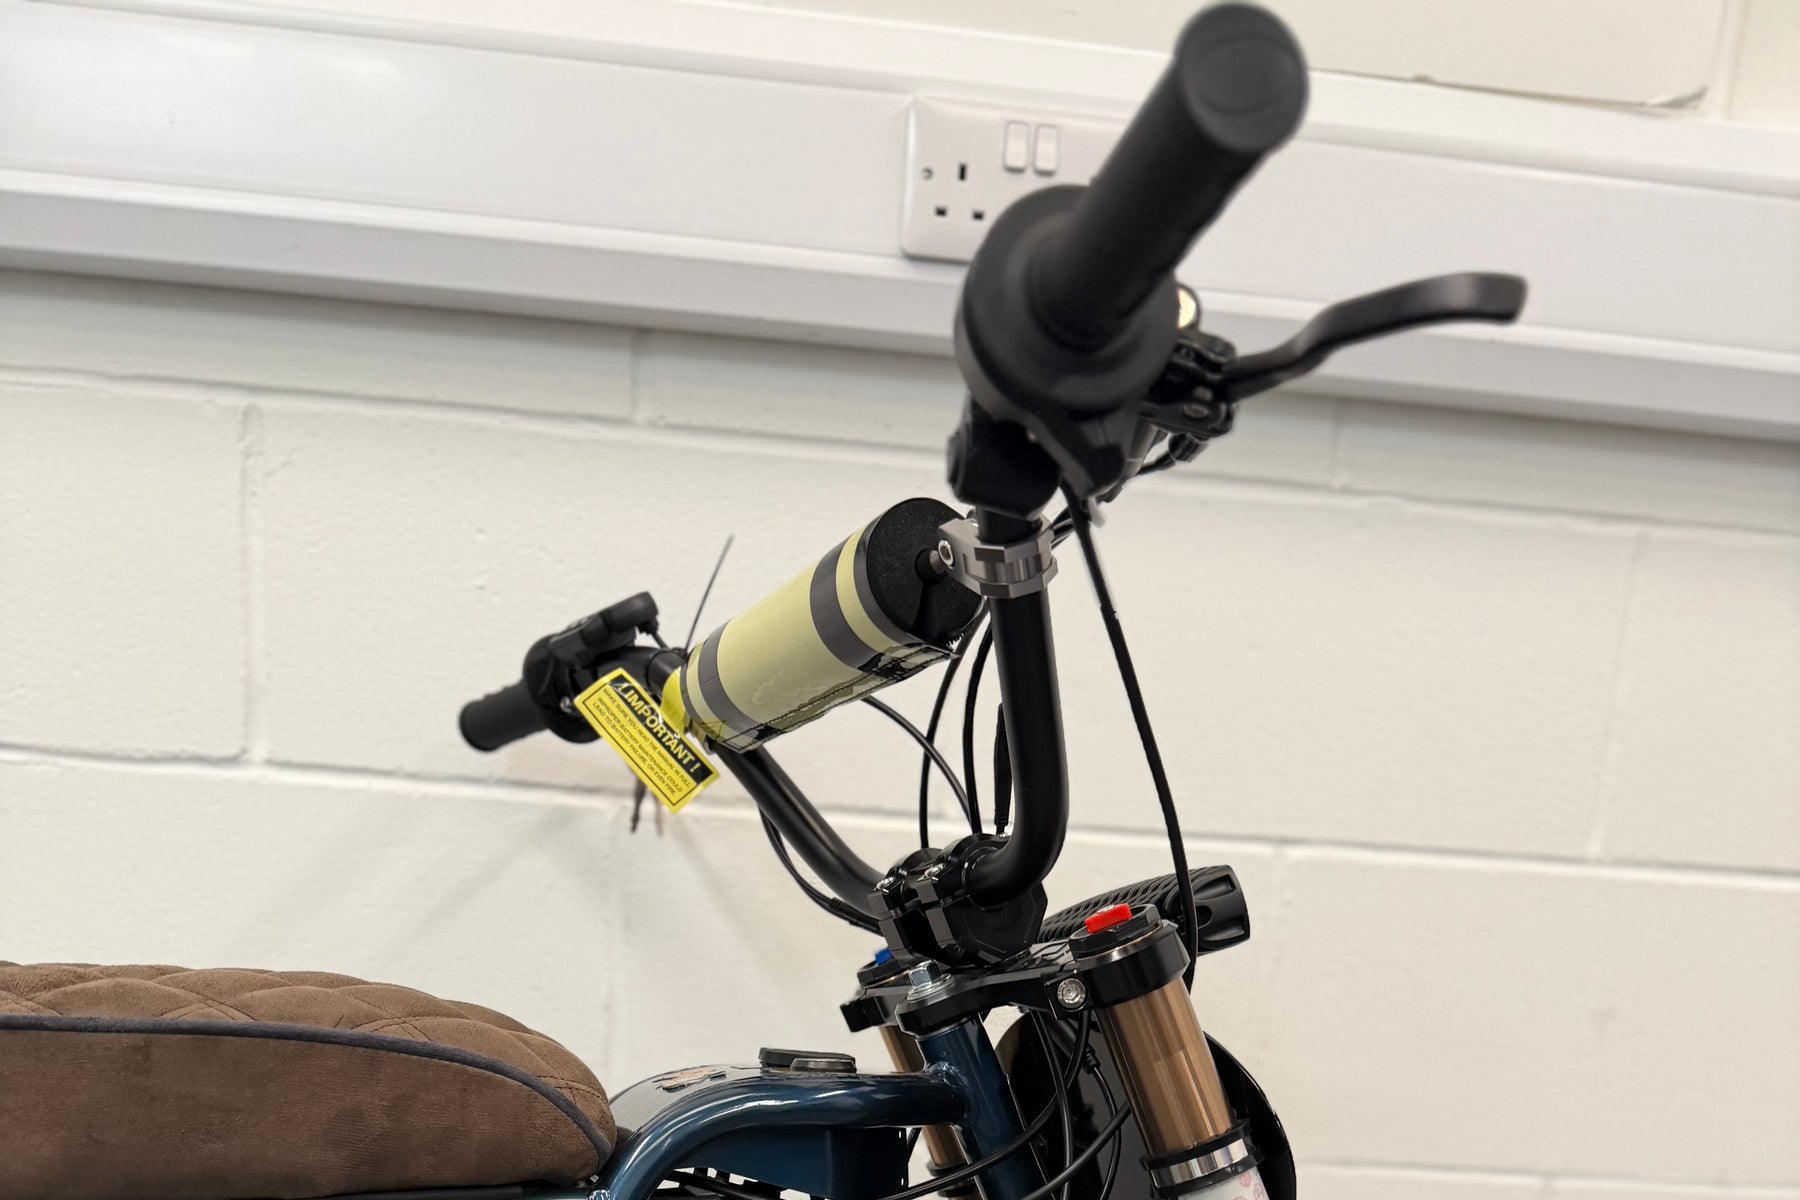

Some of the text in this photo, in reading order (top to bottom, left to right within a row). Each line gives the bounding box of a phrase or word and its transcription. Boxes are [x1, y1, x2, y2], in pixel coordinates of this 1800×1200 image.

[592, 702, 605, 716] LEAD
[604, 716, 612, 724] TO
[610, 723, 630, 745] BATTERY
[646, 763, 654, 772] OR
[653, 770, 666, 784] EVEN
[596, 697, 682, 793] IMPROPER BATTERY MAINTENANCE COULD
[602, 688, 617, 704] MAKE
[614, 702, 629, 718] SURE
[627, 717, 638, 729] YOU
[636, 728, 650, 743] READ
[648, 741, 658, 751] THE
[656, 750, 675, 770] MANUAL
[624, 689, 694, 764] IMPORTANT
